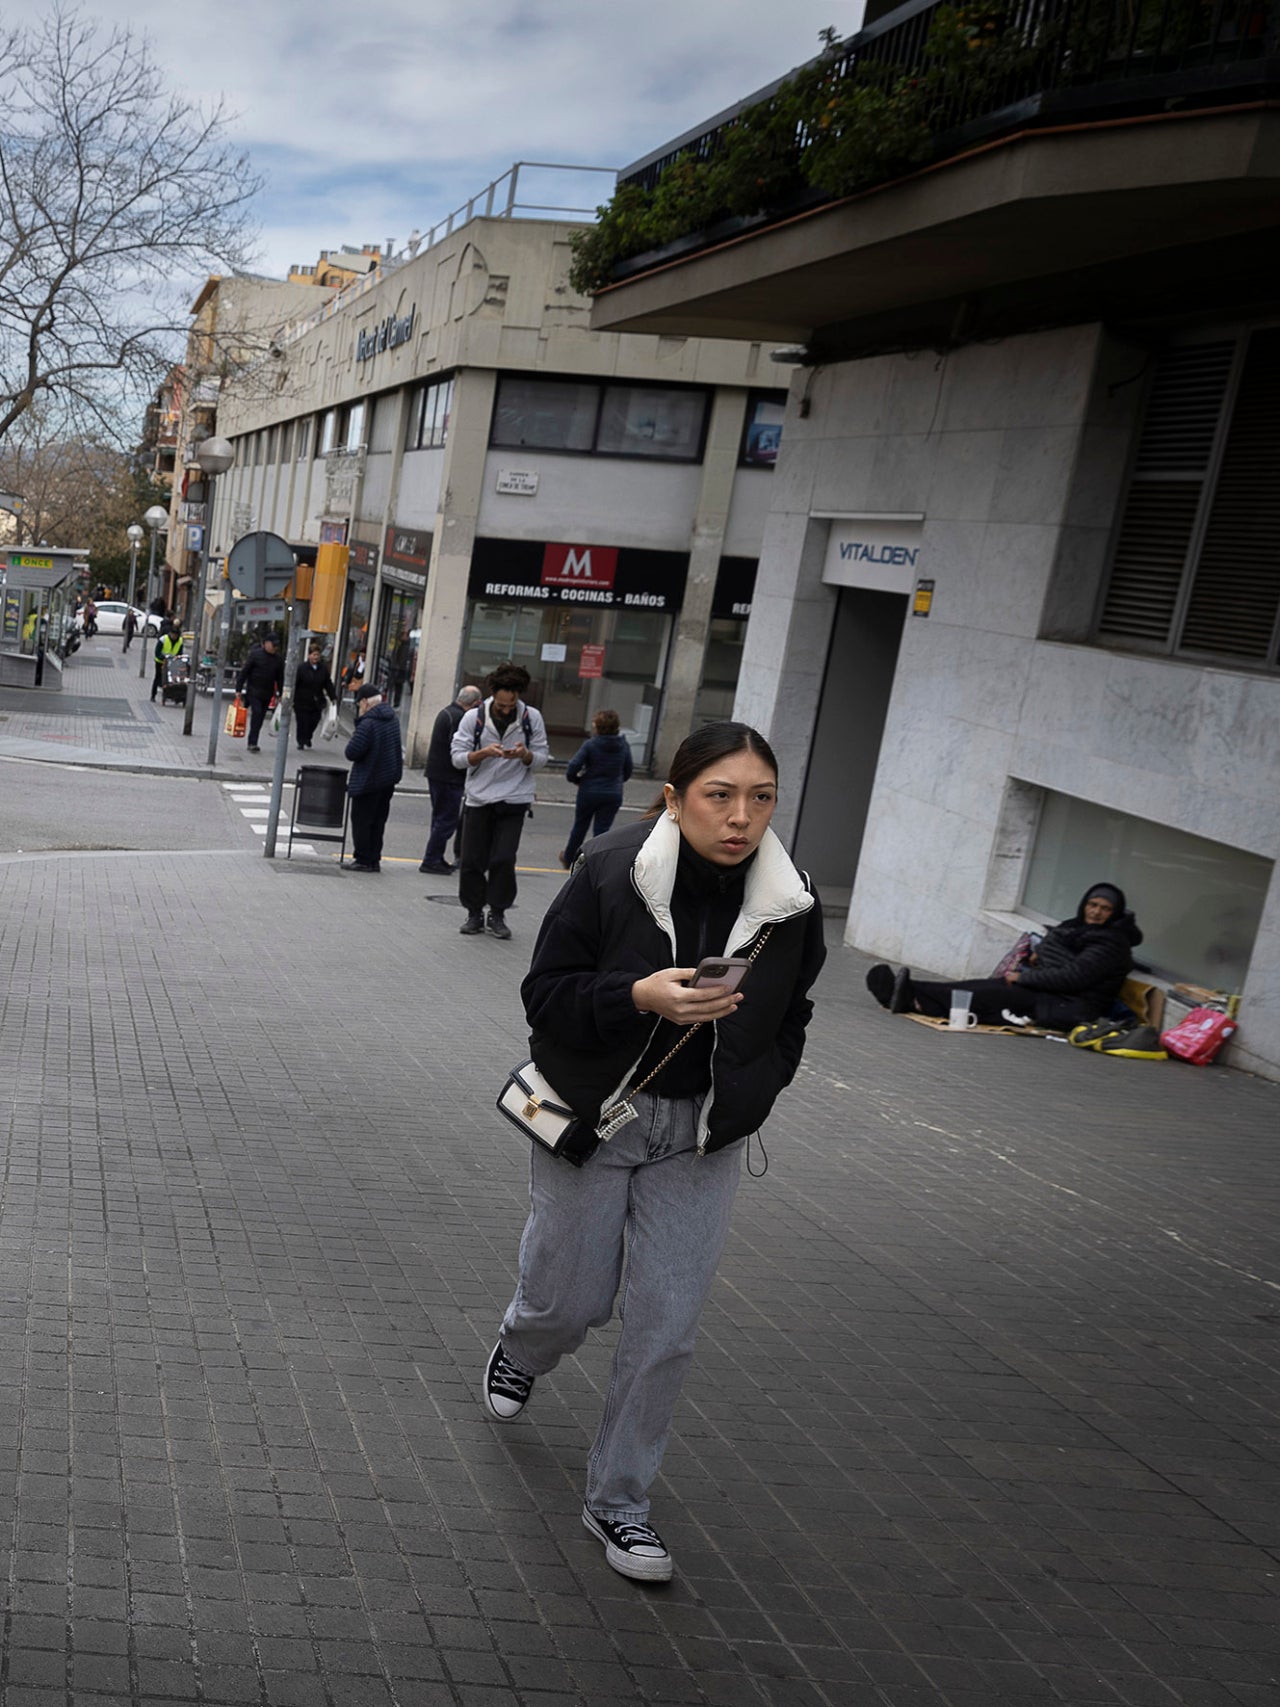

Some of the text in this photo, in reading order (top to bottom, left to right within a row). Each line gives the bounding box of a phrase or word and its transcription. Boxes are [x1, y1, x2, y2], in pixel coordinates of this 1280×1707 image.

[187, 526, 201, 549] P
[23, 558, 49, 568] ONCE
[561, 548, 592, 577] M
[840, 542, 920, 567] VITALDEN
[485, 582, 550, 599] REFORMAS
[561, 588, 613, 603] COCINAS
[624, 591, 666, 607] BAÑOS
